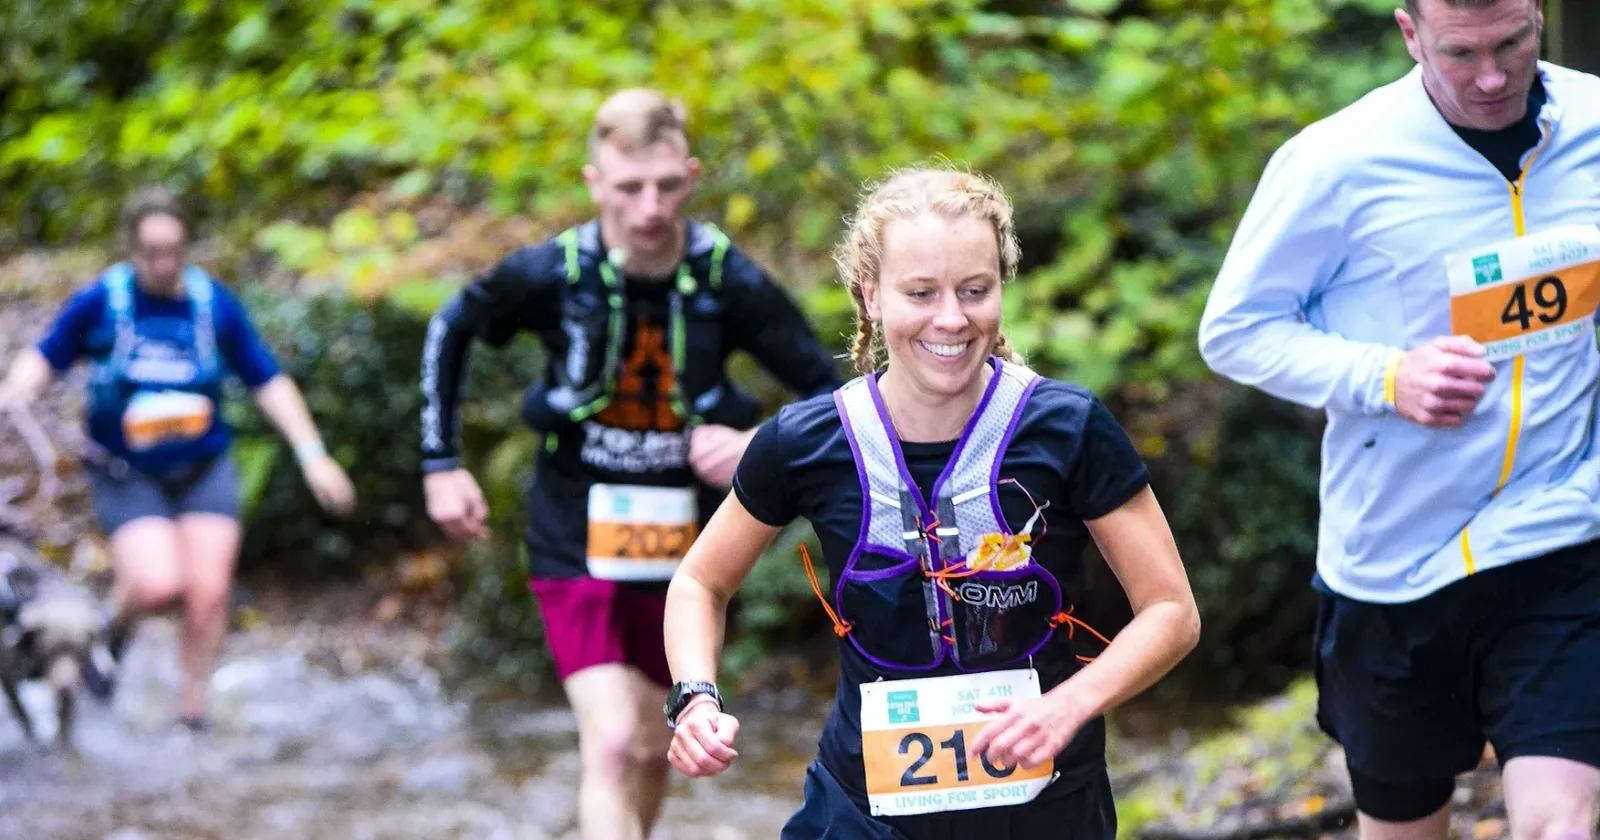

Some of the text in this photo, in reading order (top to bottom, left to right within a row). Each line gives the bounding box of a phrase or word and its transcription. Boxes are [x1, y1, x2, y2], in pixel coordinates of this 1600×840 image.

[1501, 275, 1568, 330] 49
[1485, 341, 1521, 357] IVING
[1526, 332, 1549, 346] FOR
[959, 580, 1038, 609] OMM
[957, 684, 1013, 702] SAT 4TH
[895, 784, 1029, 809] LIVING FOR SPORT
